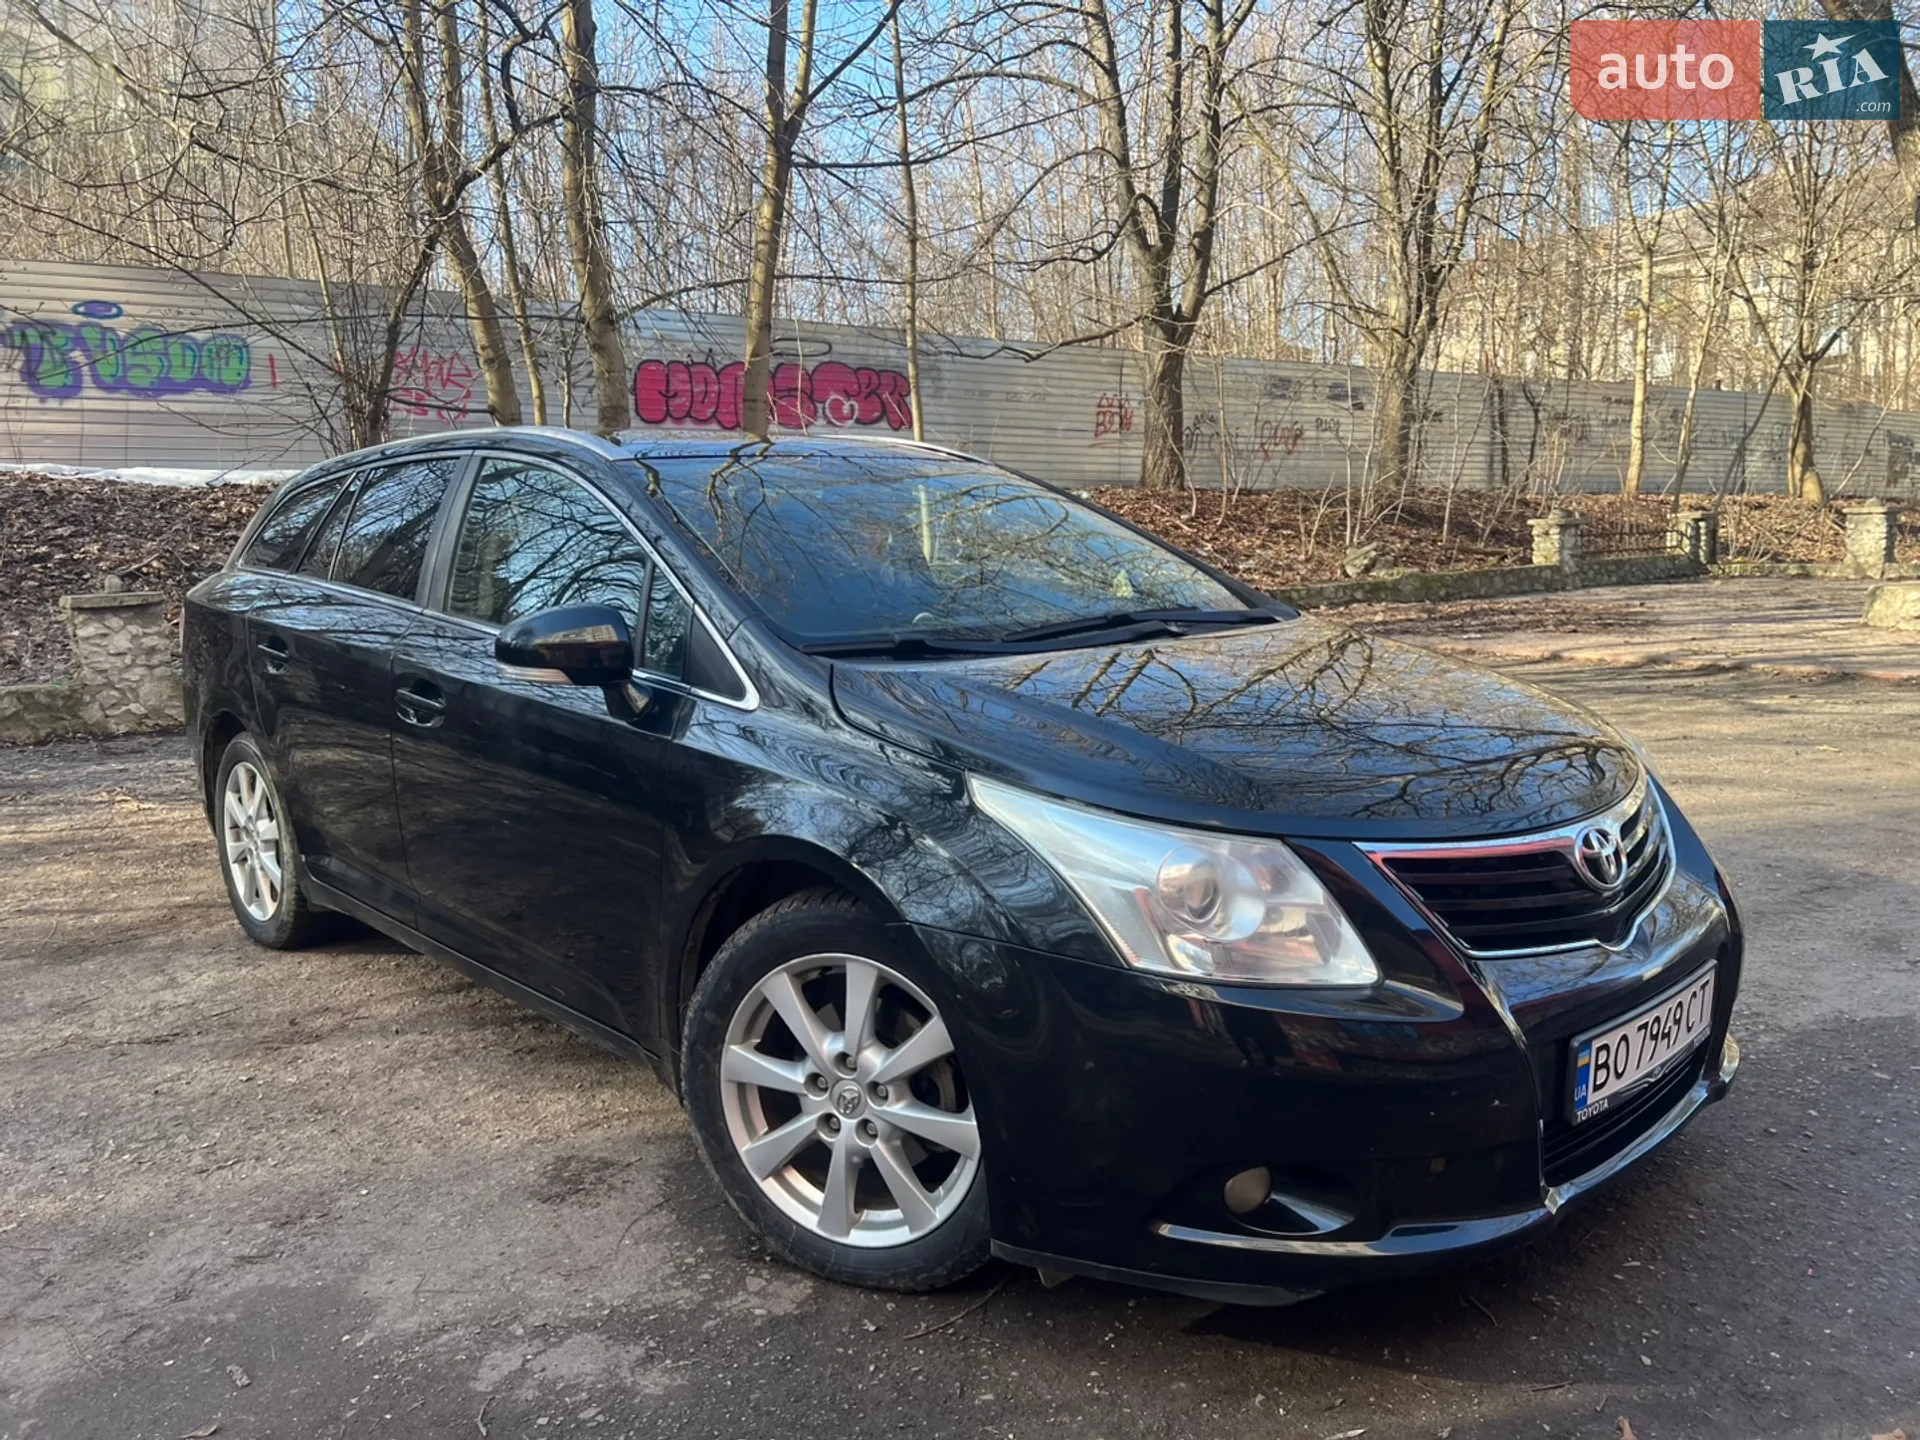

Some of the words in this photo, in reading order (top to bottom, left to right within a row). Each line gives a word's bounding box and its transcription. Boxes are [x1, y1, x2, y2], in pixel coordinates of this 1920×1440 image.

[1593, 1033, 1630, 1093] BO
[1635, 999, 1684, 1070] 7949
[1687, 978, 1710, 1033] CT
[1574, 1084, 1587, 1102] UA
[1577, 1099, 1609, 1123] TOYOTA
